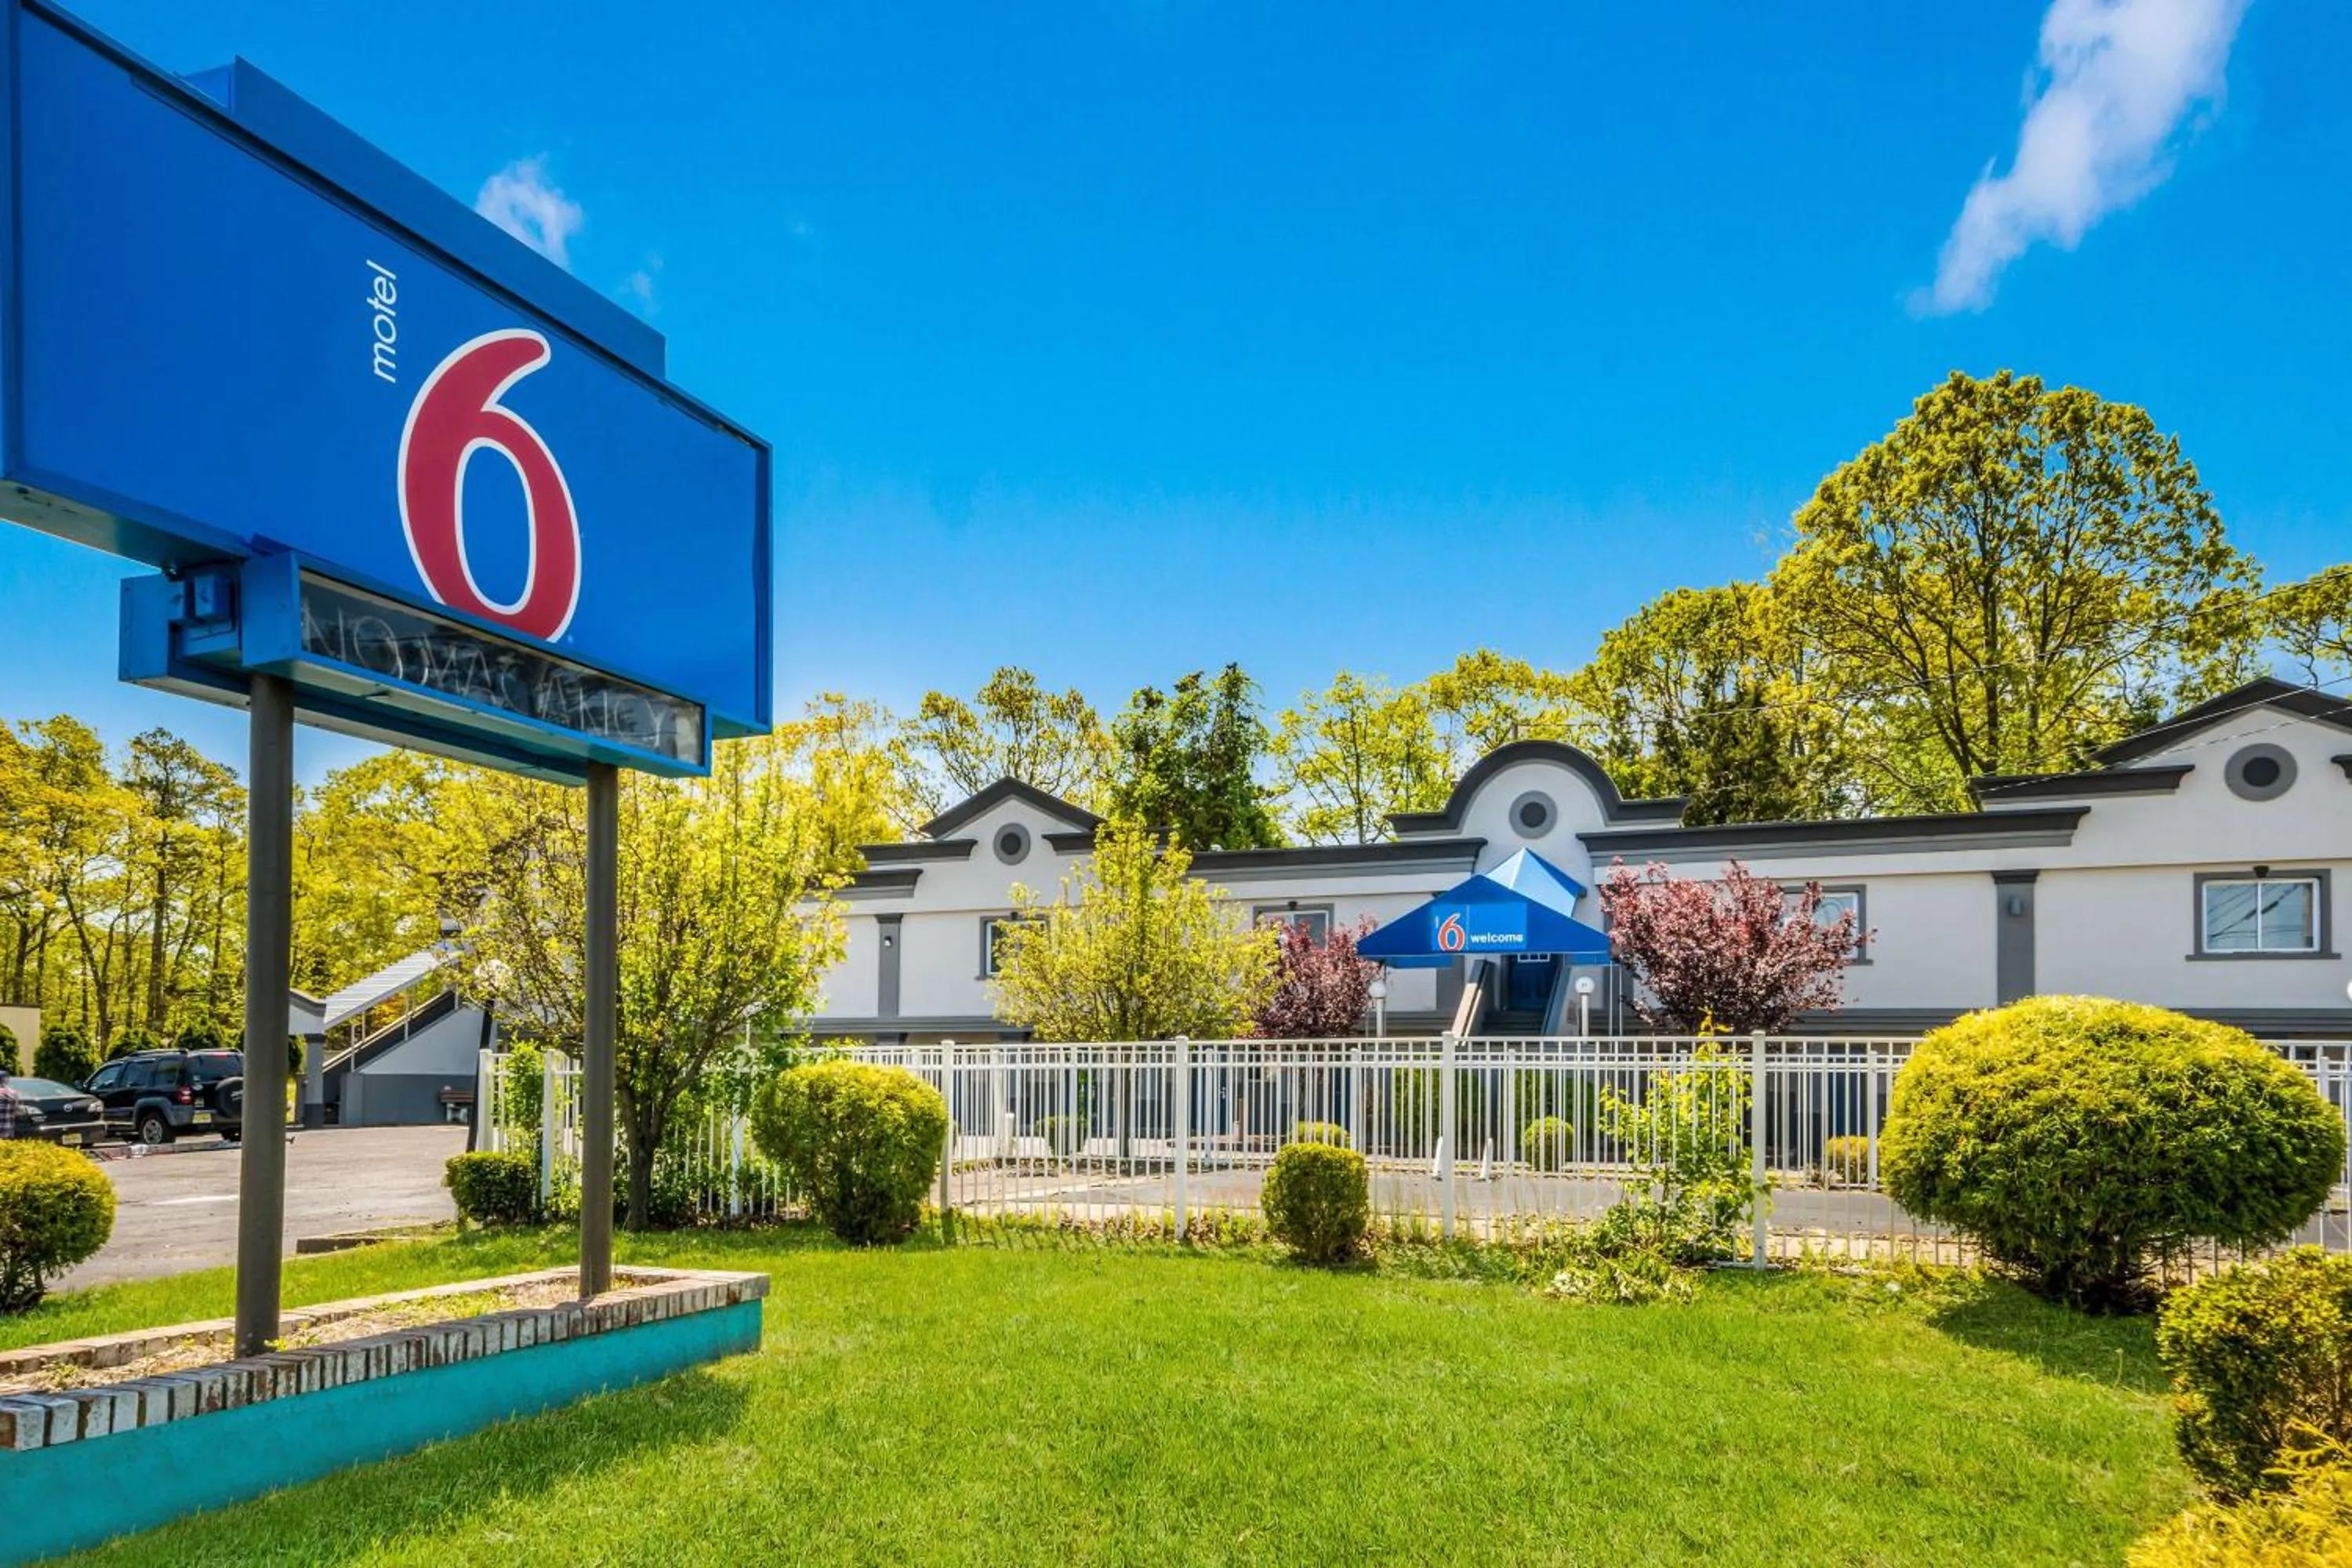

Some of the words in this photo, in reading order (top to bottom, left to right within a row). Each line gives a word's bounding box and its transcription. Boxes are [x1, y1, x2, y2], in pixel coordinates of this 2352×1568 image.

[366, 259, 397, 383] motel
[397, 328, 582, 644] 6
[1438, 913, 1465, 951] 6
[1470, 931, 1523, 944] welcome
